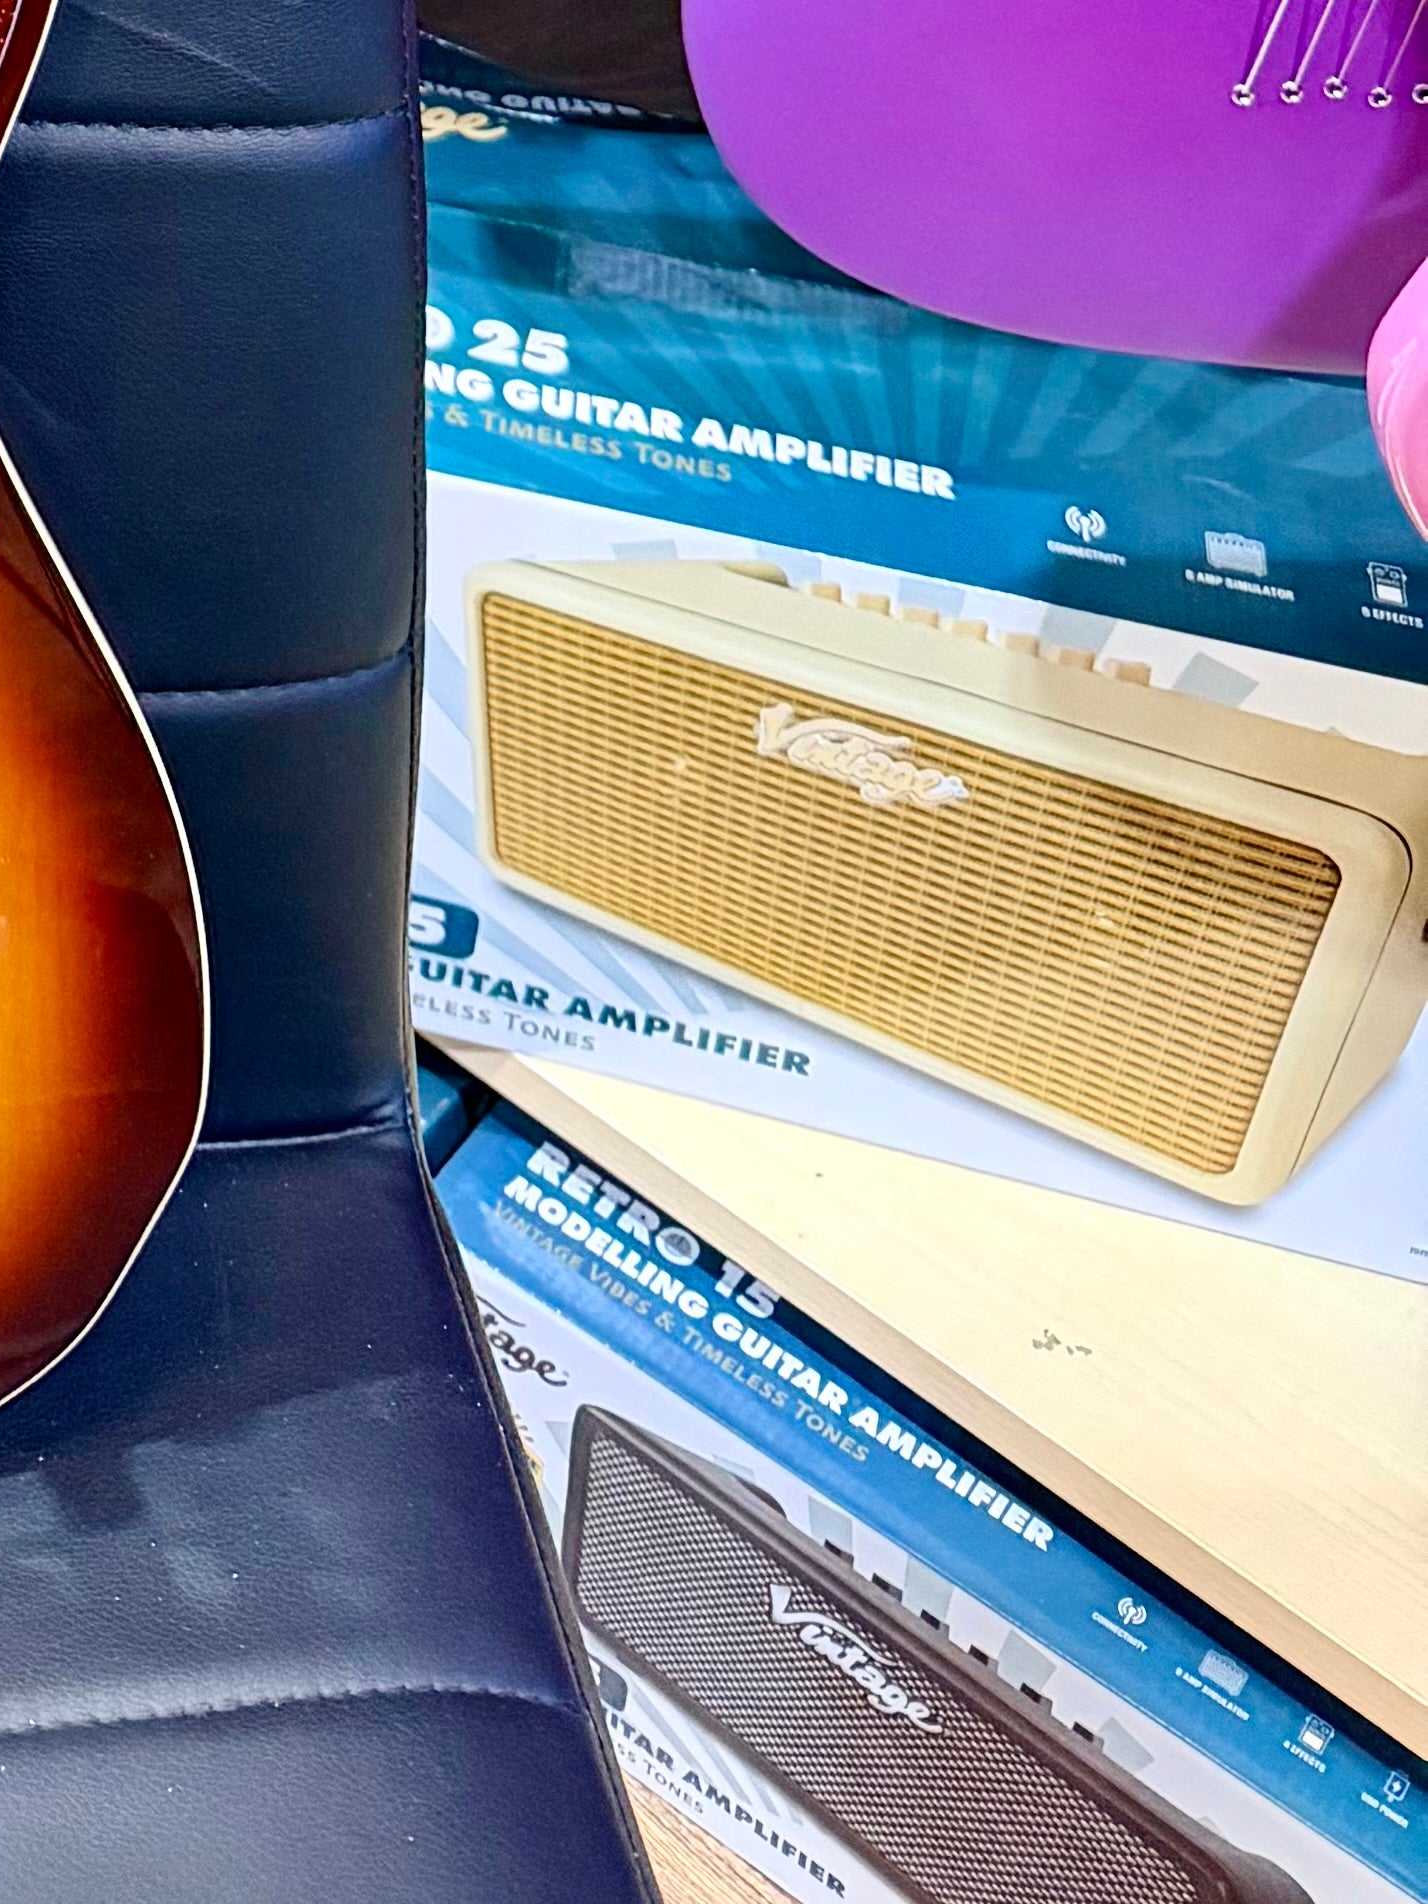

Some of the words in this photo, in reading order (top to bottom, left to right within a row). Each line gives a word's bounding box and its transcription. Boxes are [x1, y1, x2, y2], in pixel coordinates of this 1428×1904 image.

[467, 318, 570, 376] 25
[480, 409, 623, 460] TIMELESS
[637, 440, 733, 483] TONES
[502, 377, 685, 443] GUITAR
[692, 419, 956, 501] AMPLIFIER
[754, 702, 969, 809] Vintage
[504, 1012, 596, 1052] TONES
[563, 997, 812, 1077] AMPLIFIER
[527, 1141, 700, 1267] RETRO
[714, 1258, 785, 1320] 15
[503, 1175, 710, 1319] MODELLING
[712, 1312, 849, 1416] GUITAR
[849, 1405, 1055, 1552] AMPLIFIER
[682, 1325, 787, 1408] TIMELESS
[795, 1402, 869, 1463] TONES
[769, 1583, 943, 1734] Vintage
[682, 1769, 847, 1899] AMPLIFIER
